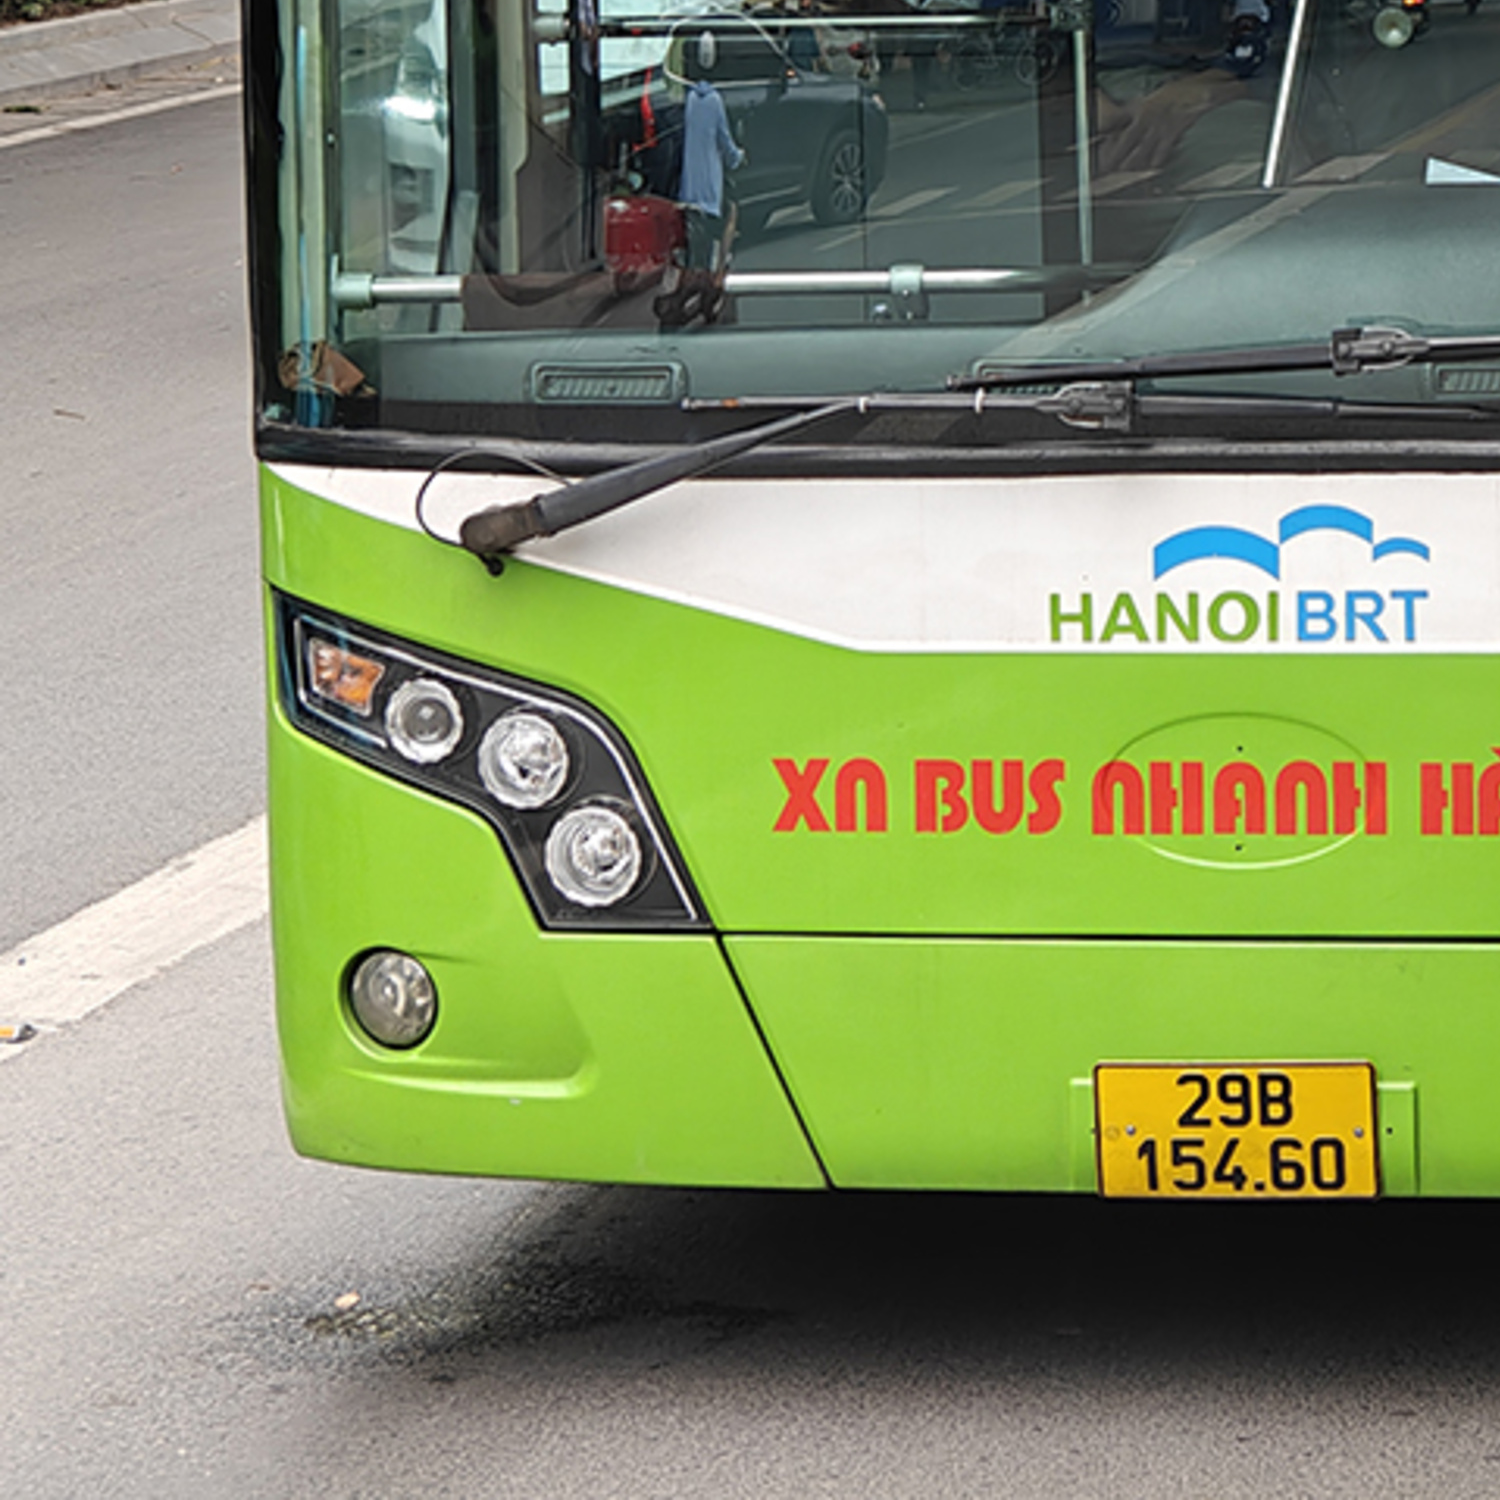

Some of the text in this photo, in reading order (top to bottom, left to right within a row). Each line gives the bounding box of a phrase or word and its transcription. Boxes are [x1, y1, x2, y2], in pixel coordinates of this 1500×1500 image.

[771, 758, 888, 833] XN
[914, 758, 1066, 835] BUS
[1091, 760, 1388, 836] NHANH
[1176, 1072, 1294, 1128] 29B
[1137, 1137, 1346, 1192] 154.60
